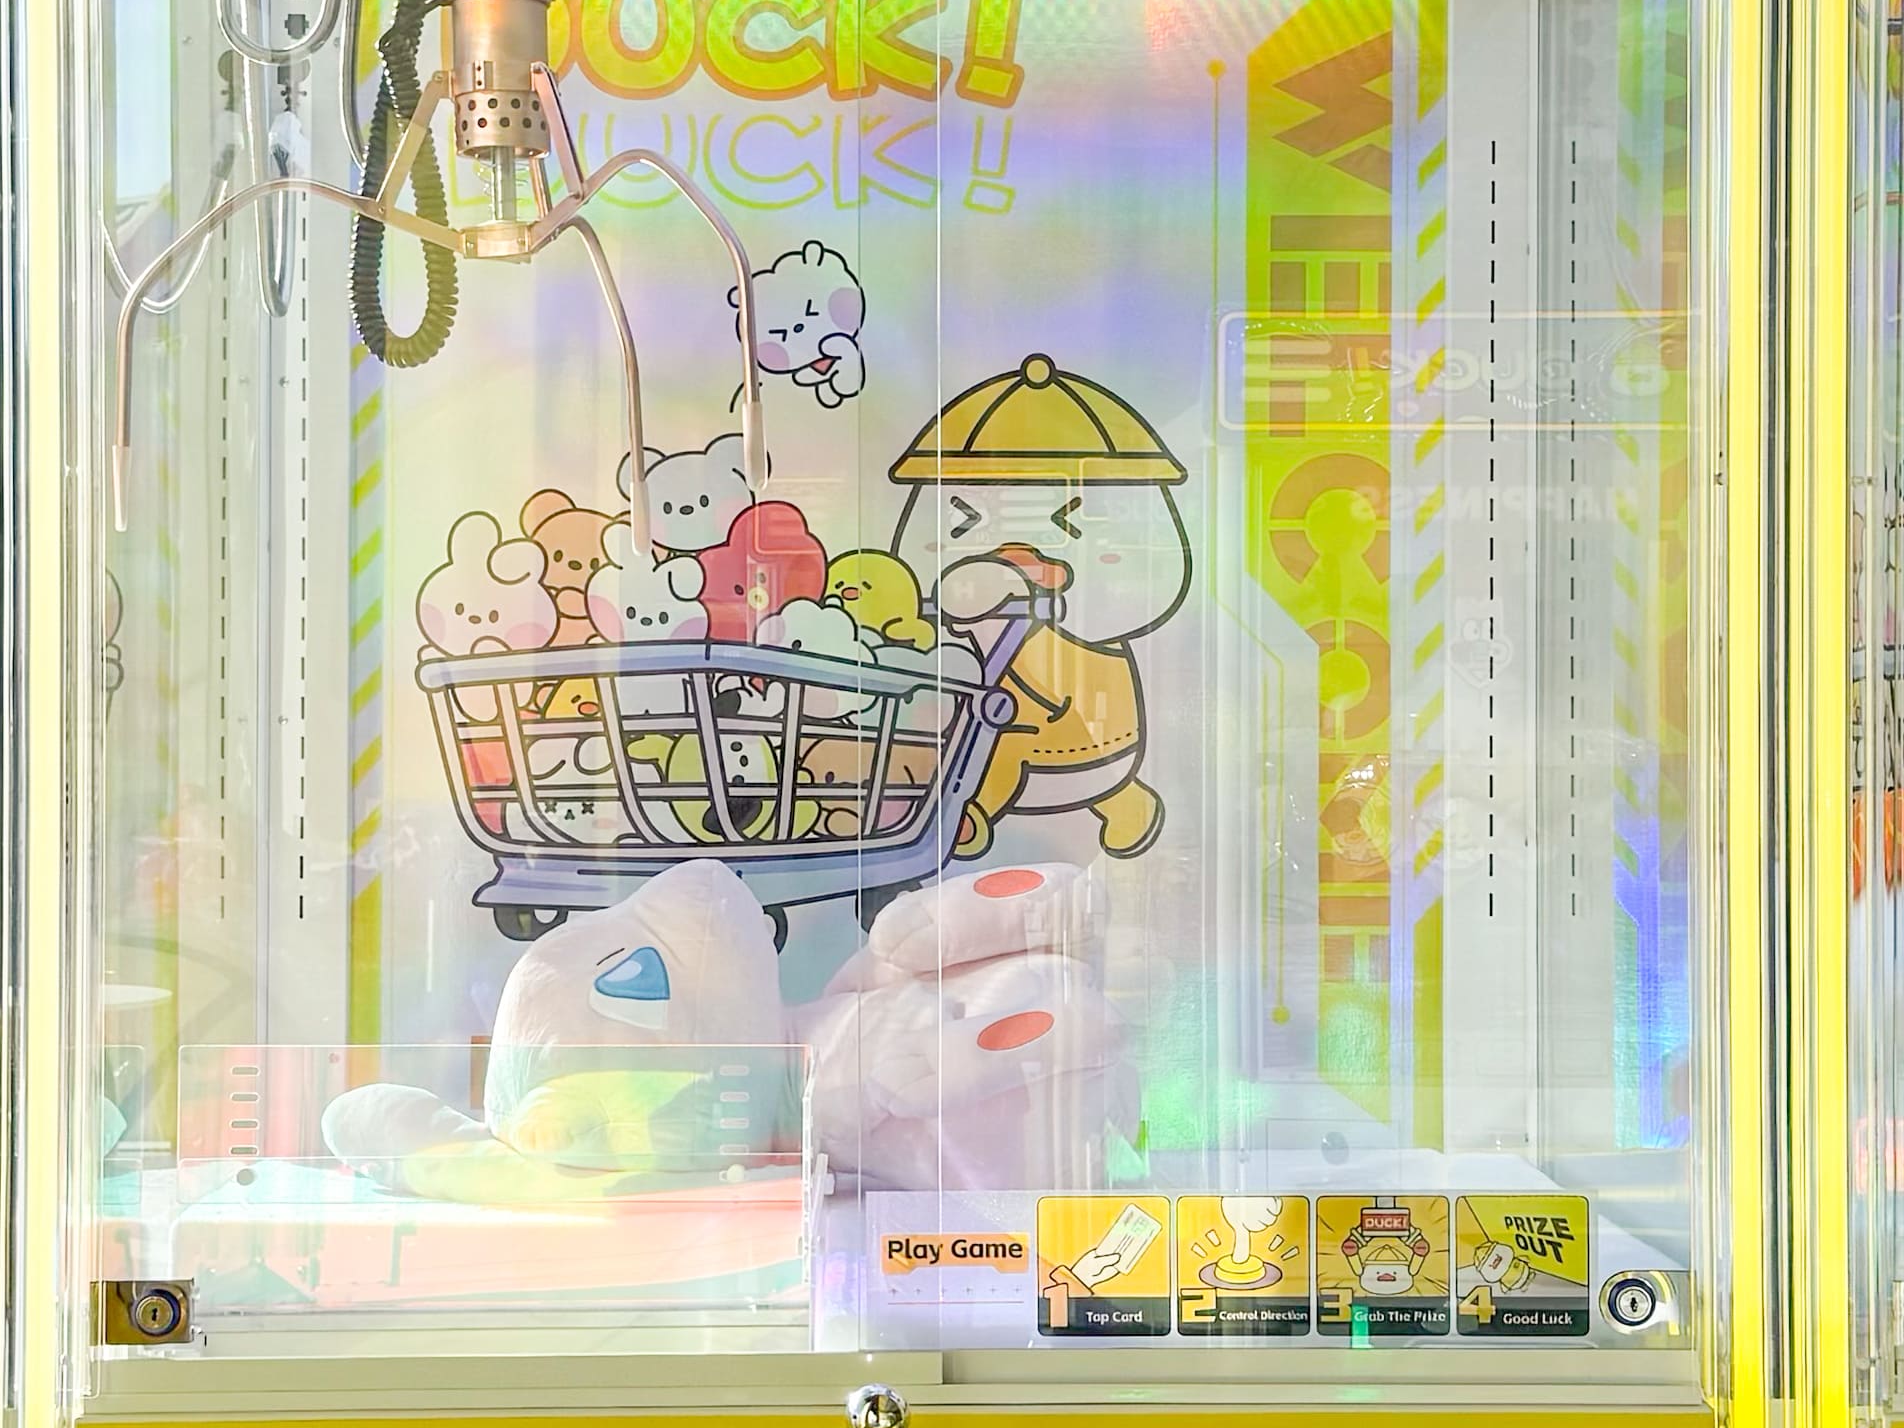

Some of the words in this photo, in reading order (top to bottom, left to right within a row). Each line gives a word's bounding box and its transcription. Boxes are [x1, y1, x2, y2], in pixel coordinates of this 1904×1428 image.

[1504, 1215, 1574, 1241] PRIZE
[887, 1238, 943, 1264] Play
[950, 1239, 1024, 1259] Game
[1515, 1233, 1564, 1264] OUT
[1042, 1282, 1069, 1328] 1
[1086, 1311, 1110, 1324] Tap
[1112, 1310, 1143, 1323] Card
[1179, 1287, 1217, 1323] 2
[1219, 1310, 1258, 1322] Control
[1260, 1310, 1308, 1322] Direction
[1319, 1287, 1354, 1324] 3
[1389, 1310, 1411, 1322] The
[1414, 1310, 1446, 1322] Prize
[1458, 1285, 1496, 1324] 4
[1503, 1312, 1537, 1325] Good
[1541, 1312, 1573, 1325] Luck
